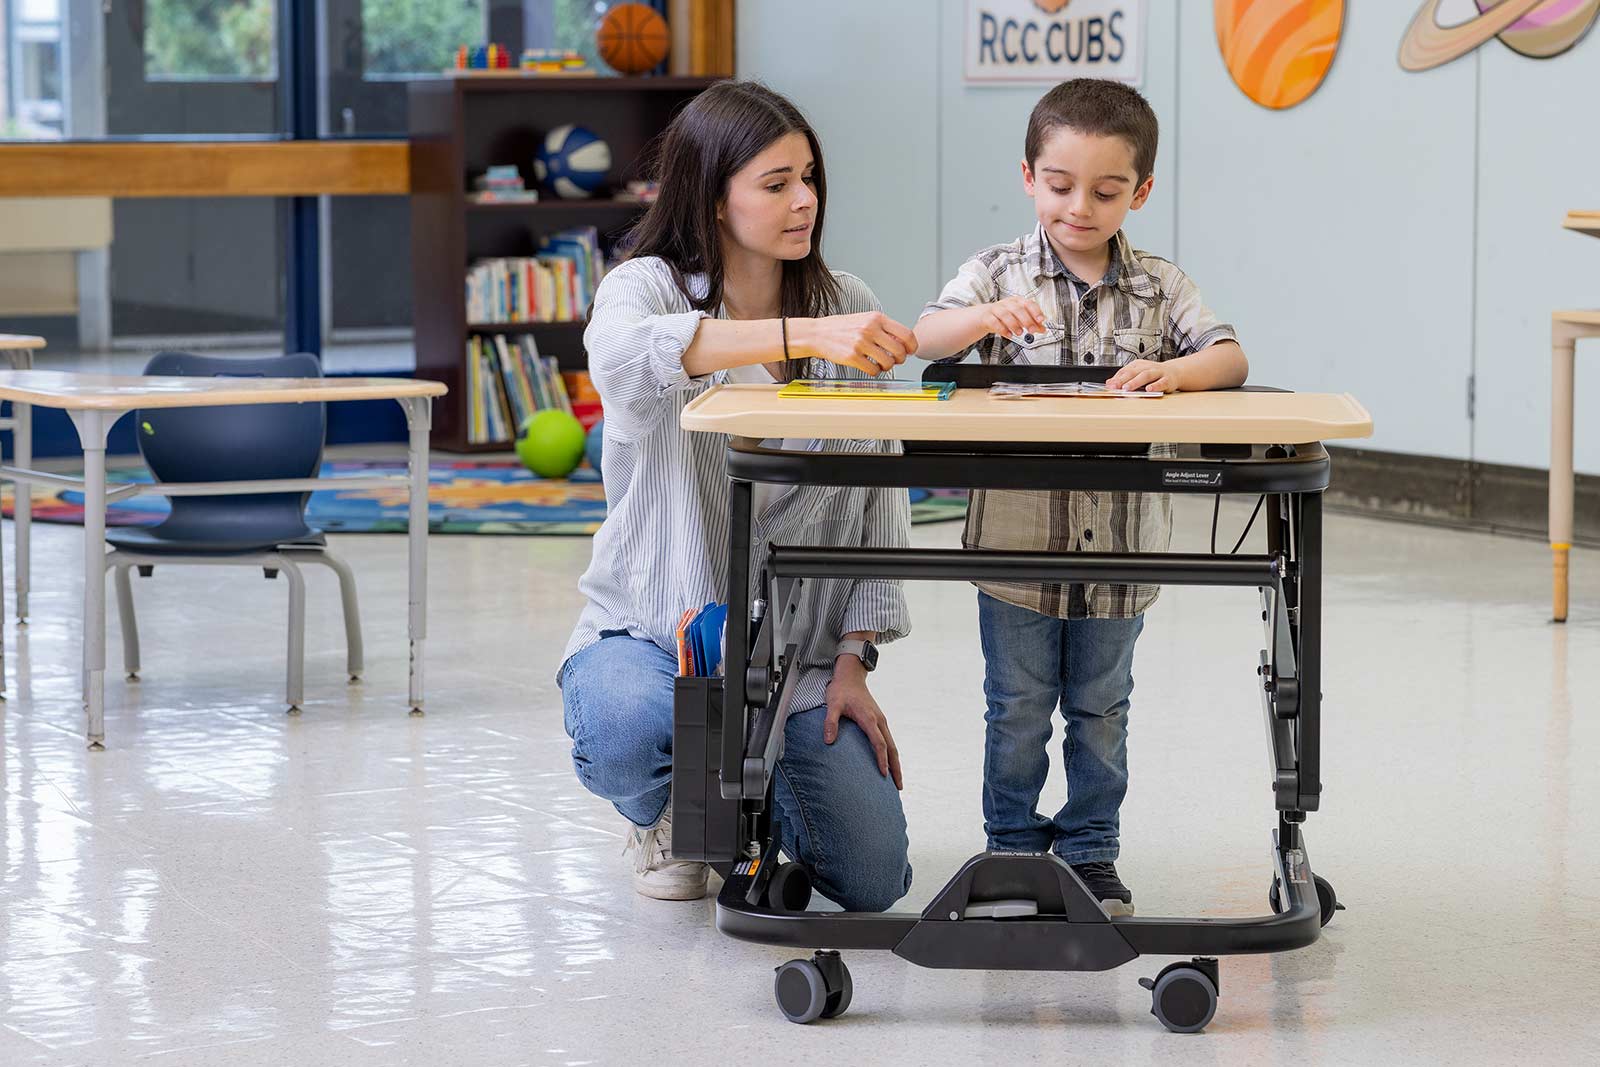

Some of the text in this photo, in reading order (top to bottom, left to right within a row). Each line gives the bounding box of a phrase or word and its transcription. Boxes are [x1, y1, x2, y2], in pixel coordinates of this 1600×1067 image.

[979, 10, 1124, 63] RCC CUBS
[1165, 471, 1180, 479] Angle
